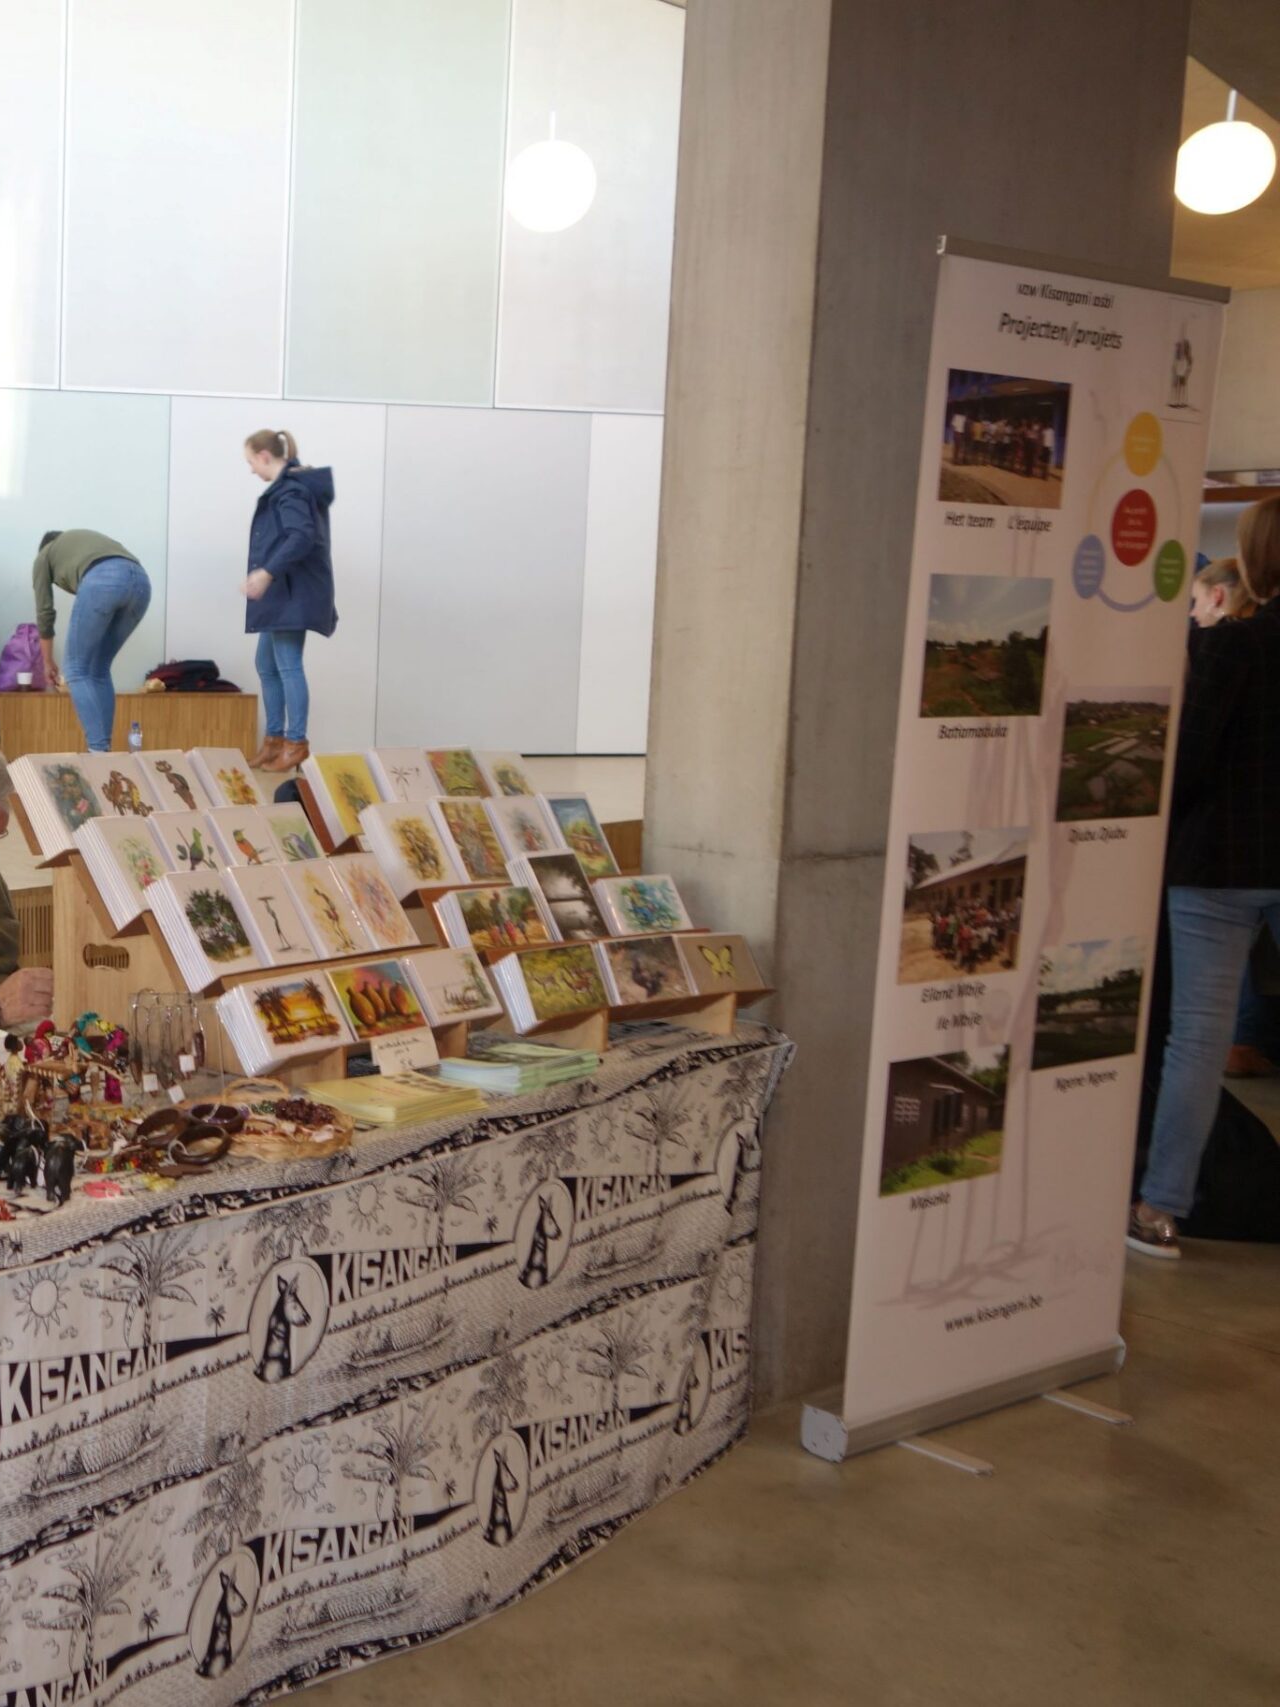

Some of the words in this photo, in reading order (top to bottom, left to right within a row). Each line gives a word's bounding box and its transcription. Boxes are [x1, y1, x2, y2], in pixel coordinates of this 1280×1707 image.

[1040, 284, 1091, 306] Kisangani
[576, 1174, 671, 1222] KISANGANI
[331, 1244, 457, 1307] KISANGANI
[0, 1342, 167, 1427] KISANGANI
[529, 1408, 631, 1471] KISANGANI
[262, 1514, 415, 1587] KISANGANI
